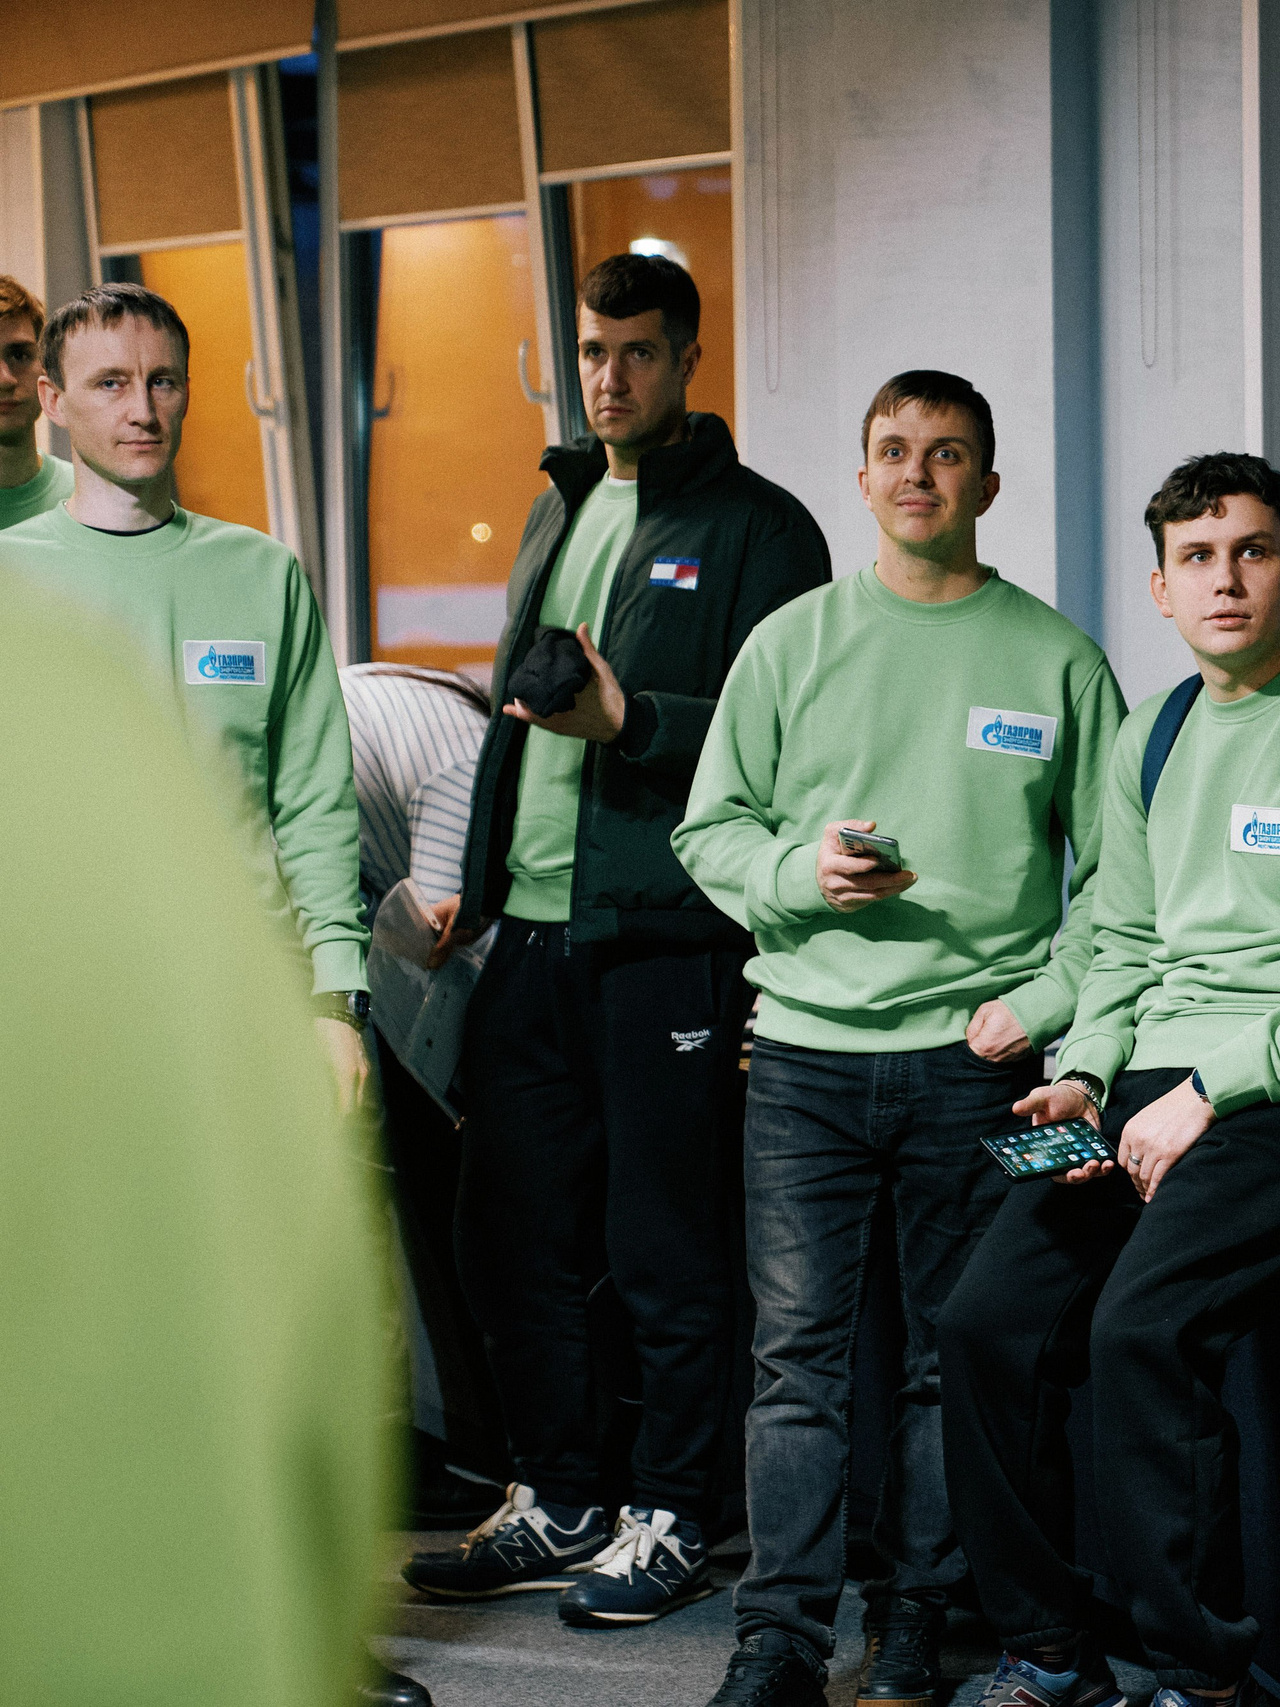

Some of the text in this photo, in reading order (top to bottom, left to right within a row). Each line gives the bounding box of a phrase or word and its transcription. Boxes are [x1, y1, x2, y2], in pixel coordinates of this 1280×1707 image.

[218, 654, 254, 667] ГАЗПРОМ
[1002, 724, 1043, 740] ГАЗПРОМ
[670, 1028, 711, 1040] Reebok
